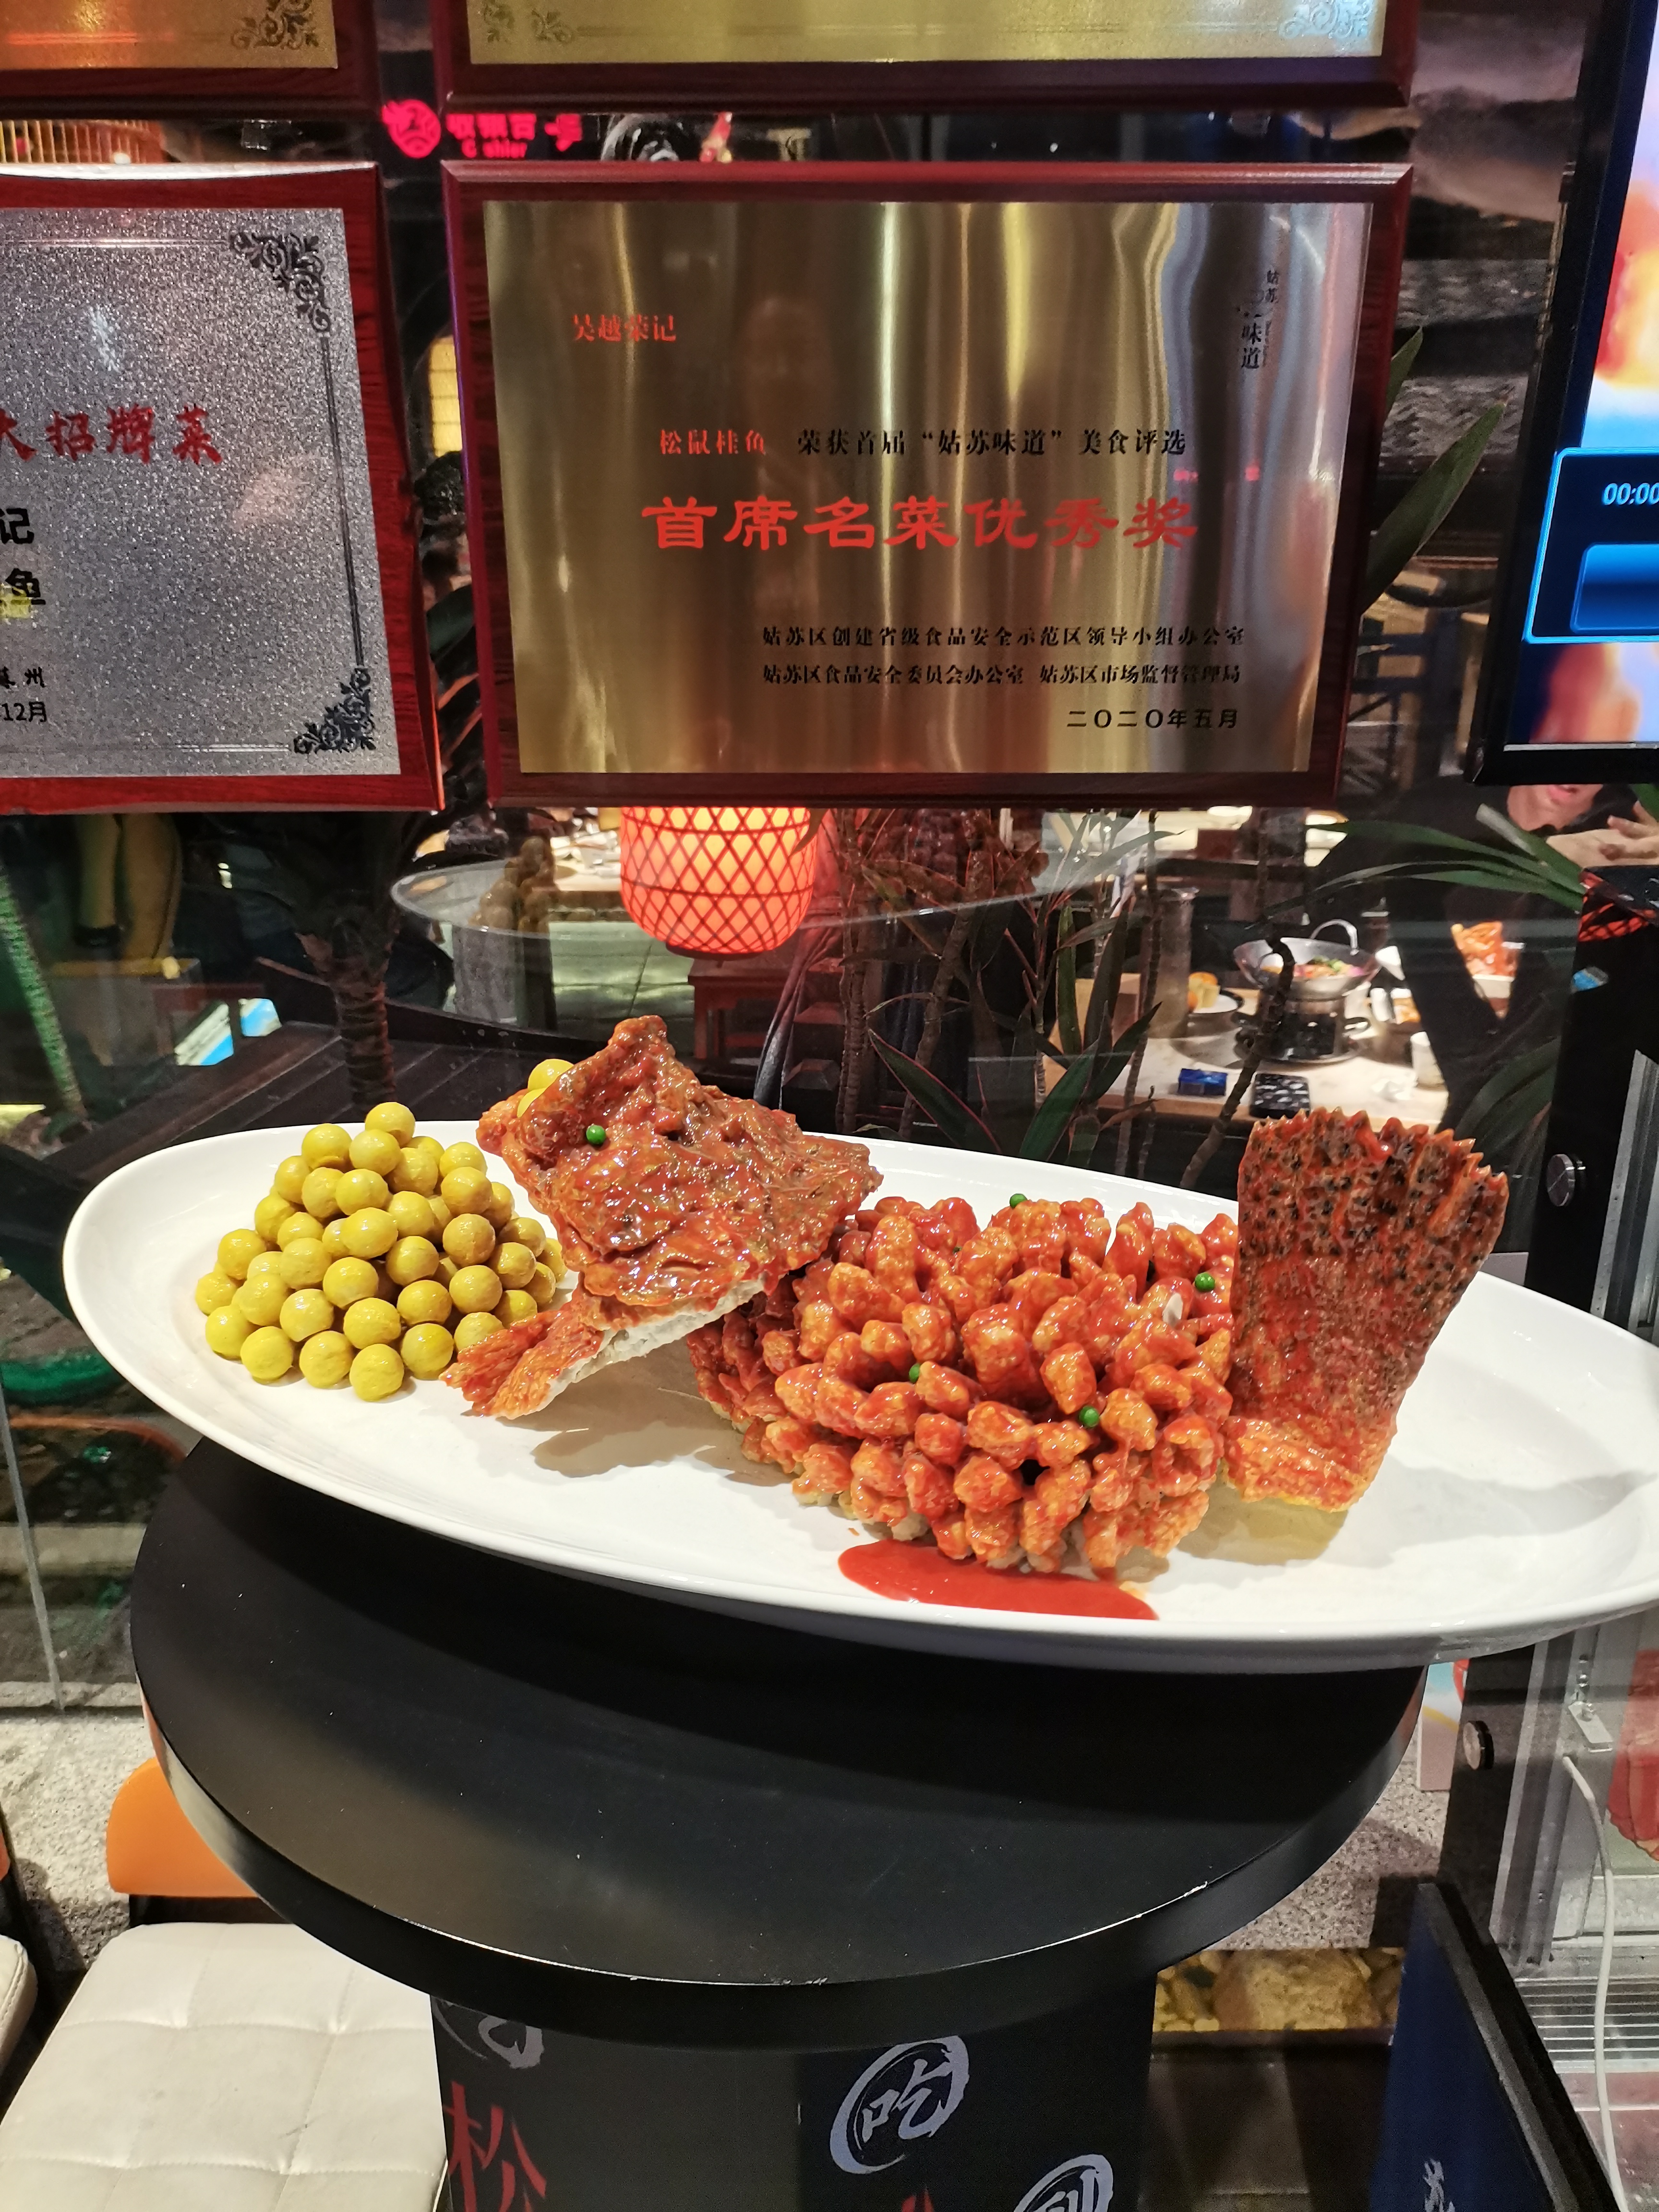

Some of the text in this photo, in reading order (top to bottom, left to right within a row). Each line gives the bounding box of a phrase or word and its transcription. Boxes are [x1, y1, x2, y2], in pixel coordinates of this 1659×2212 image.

[573, 313, 677, 342] 吴越荣记
[660, 428, 768, 456] 松鼠桂鱼
[641, 495, 1198, 551] 首席名菜优秀奖
[762, 626, 1246, 647] 姑苏区创建省级食品安全示范区领导小组办公室
[762, 664, 1241, 685] 姑苏区食品安全委员会办公室 姑苏区市场监督管理局
